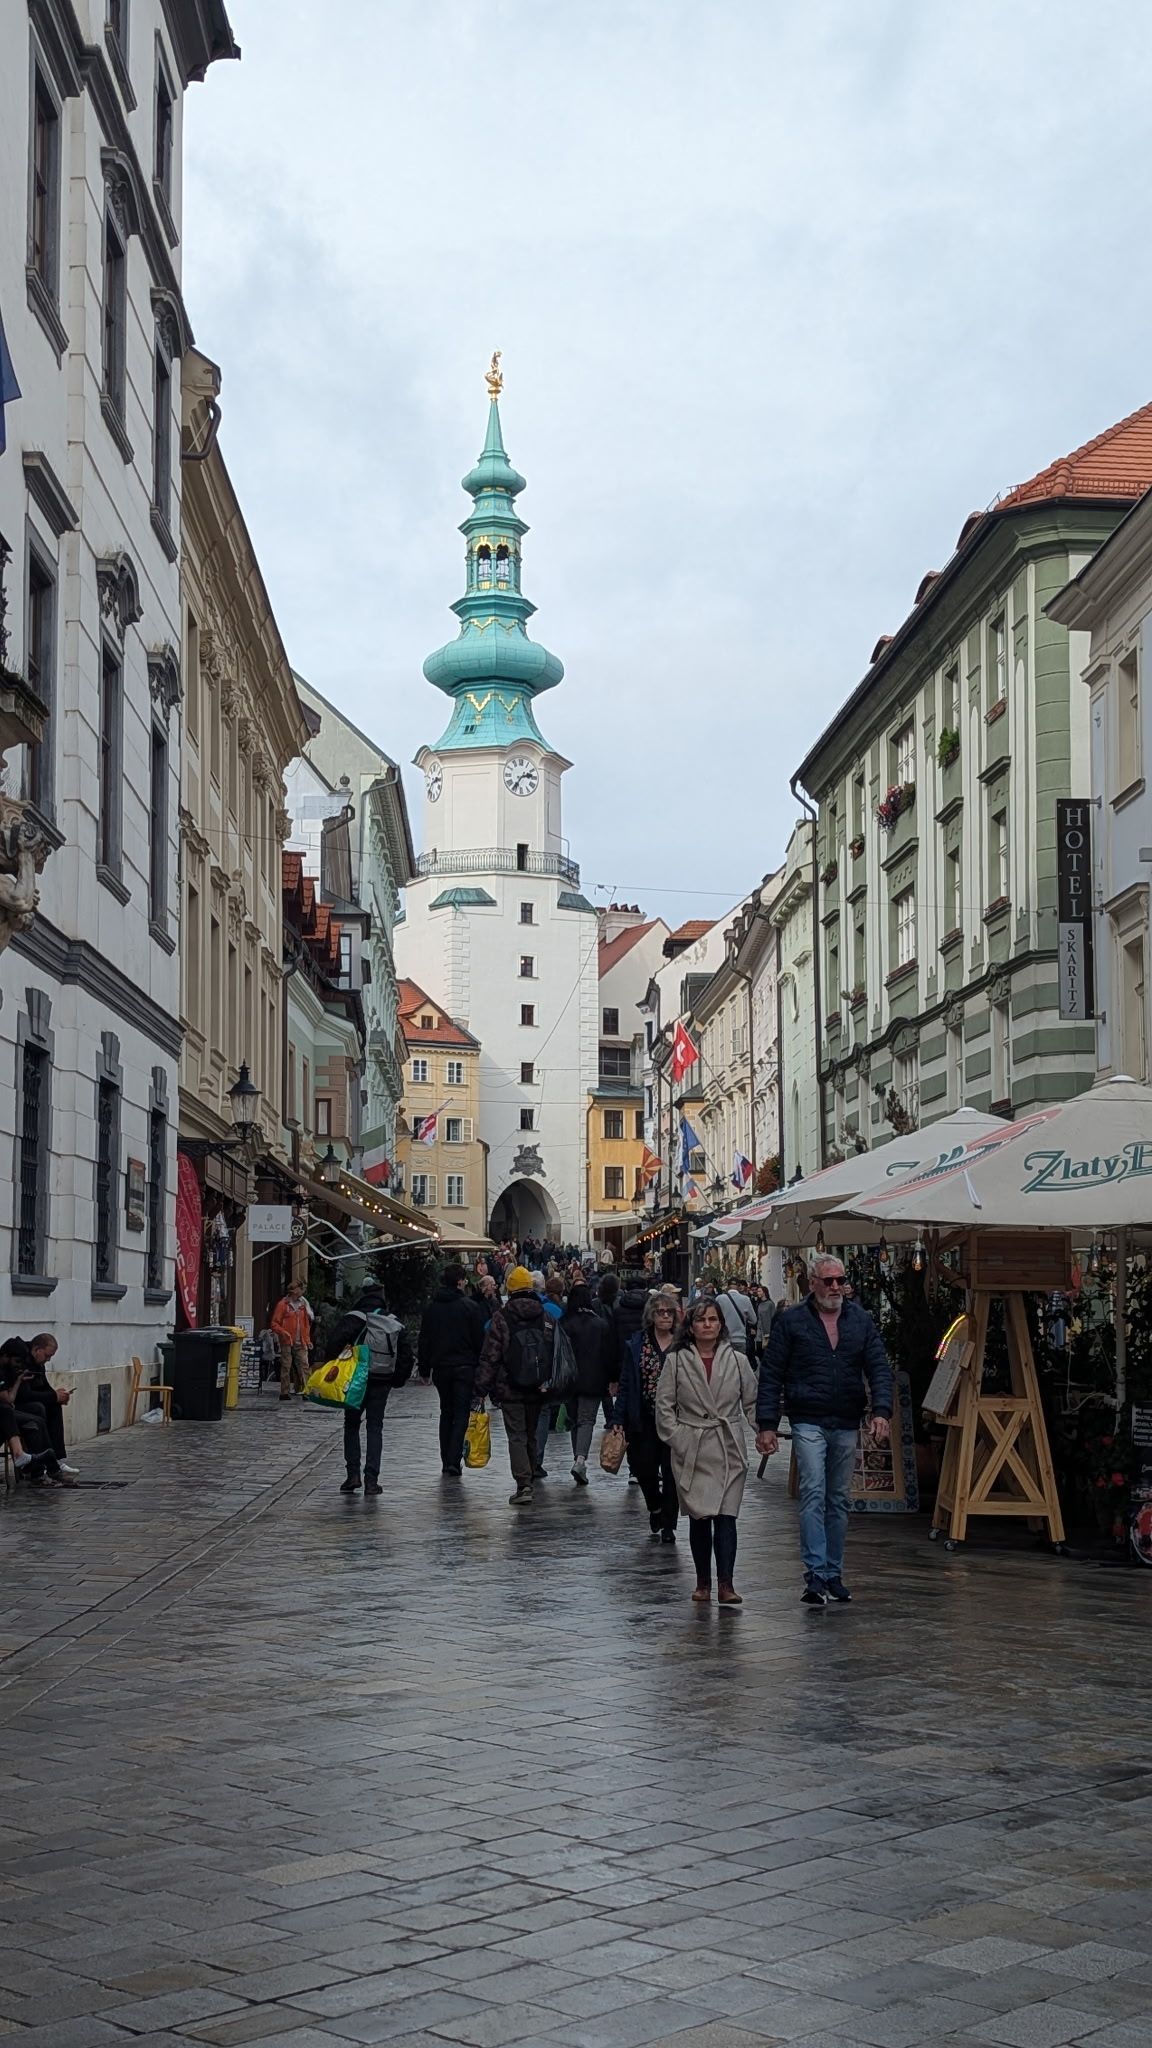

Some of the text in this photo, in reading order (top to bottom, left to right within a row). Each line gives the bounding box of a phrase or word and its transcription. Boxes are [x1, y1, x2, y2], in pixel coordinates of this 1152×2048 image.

[1064, 807, 1084, 918] HOTEL
[1066, 929, 1078, 1014] SKARITZ
[252, 1223, 287, 1231] PALACE
